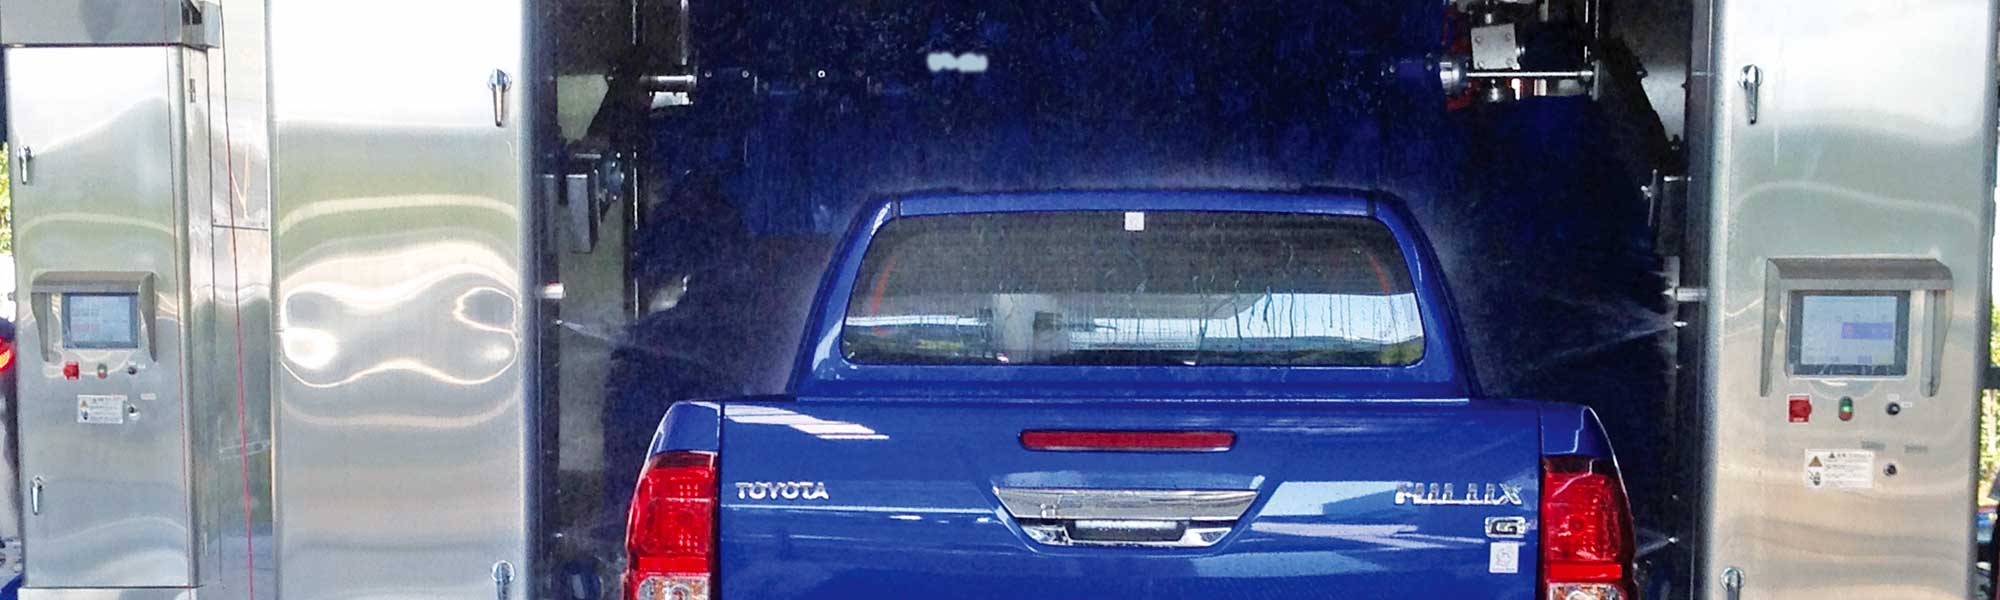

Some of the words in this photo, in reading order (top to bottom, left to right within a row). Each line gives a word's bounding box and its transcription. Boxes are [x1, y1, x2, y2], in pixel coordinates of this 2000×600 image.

[735, 481, 829, 500] TOYOTA
[1395, 482, 1522, 505] HILUX
[1489, 519, 1519, 535] G
